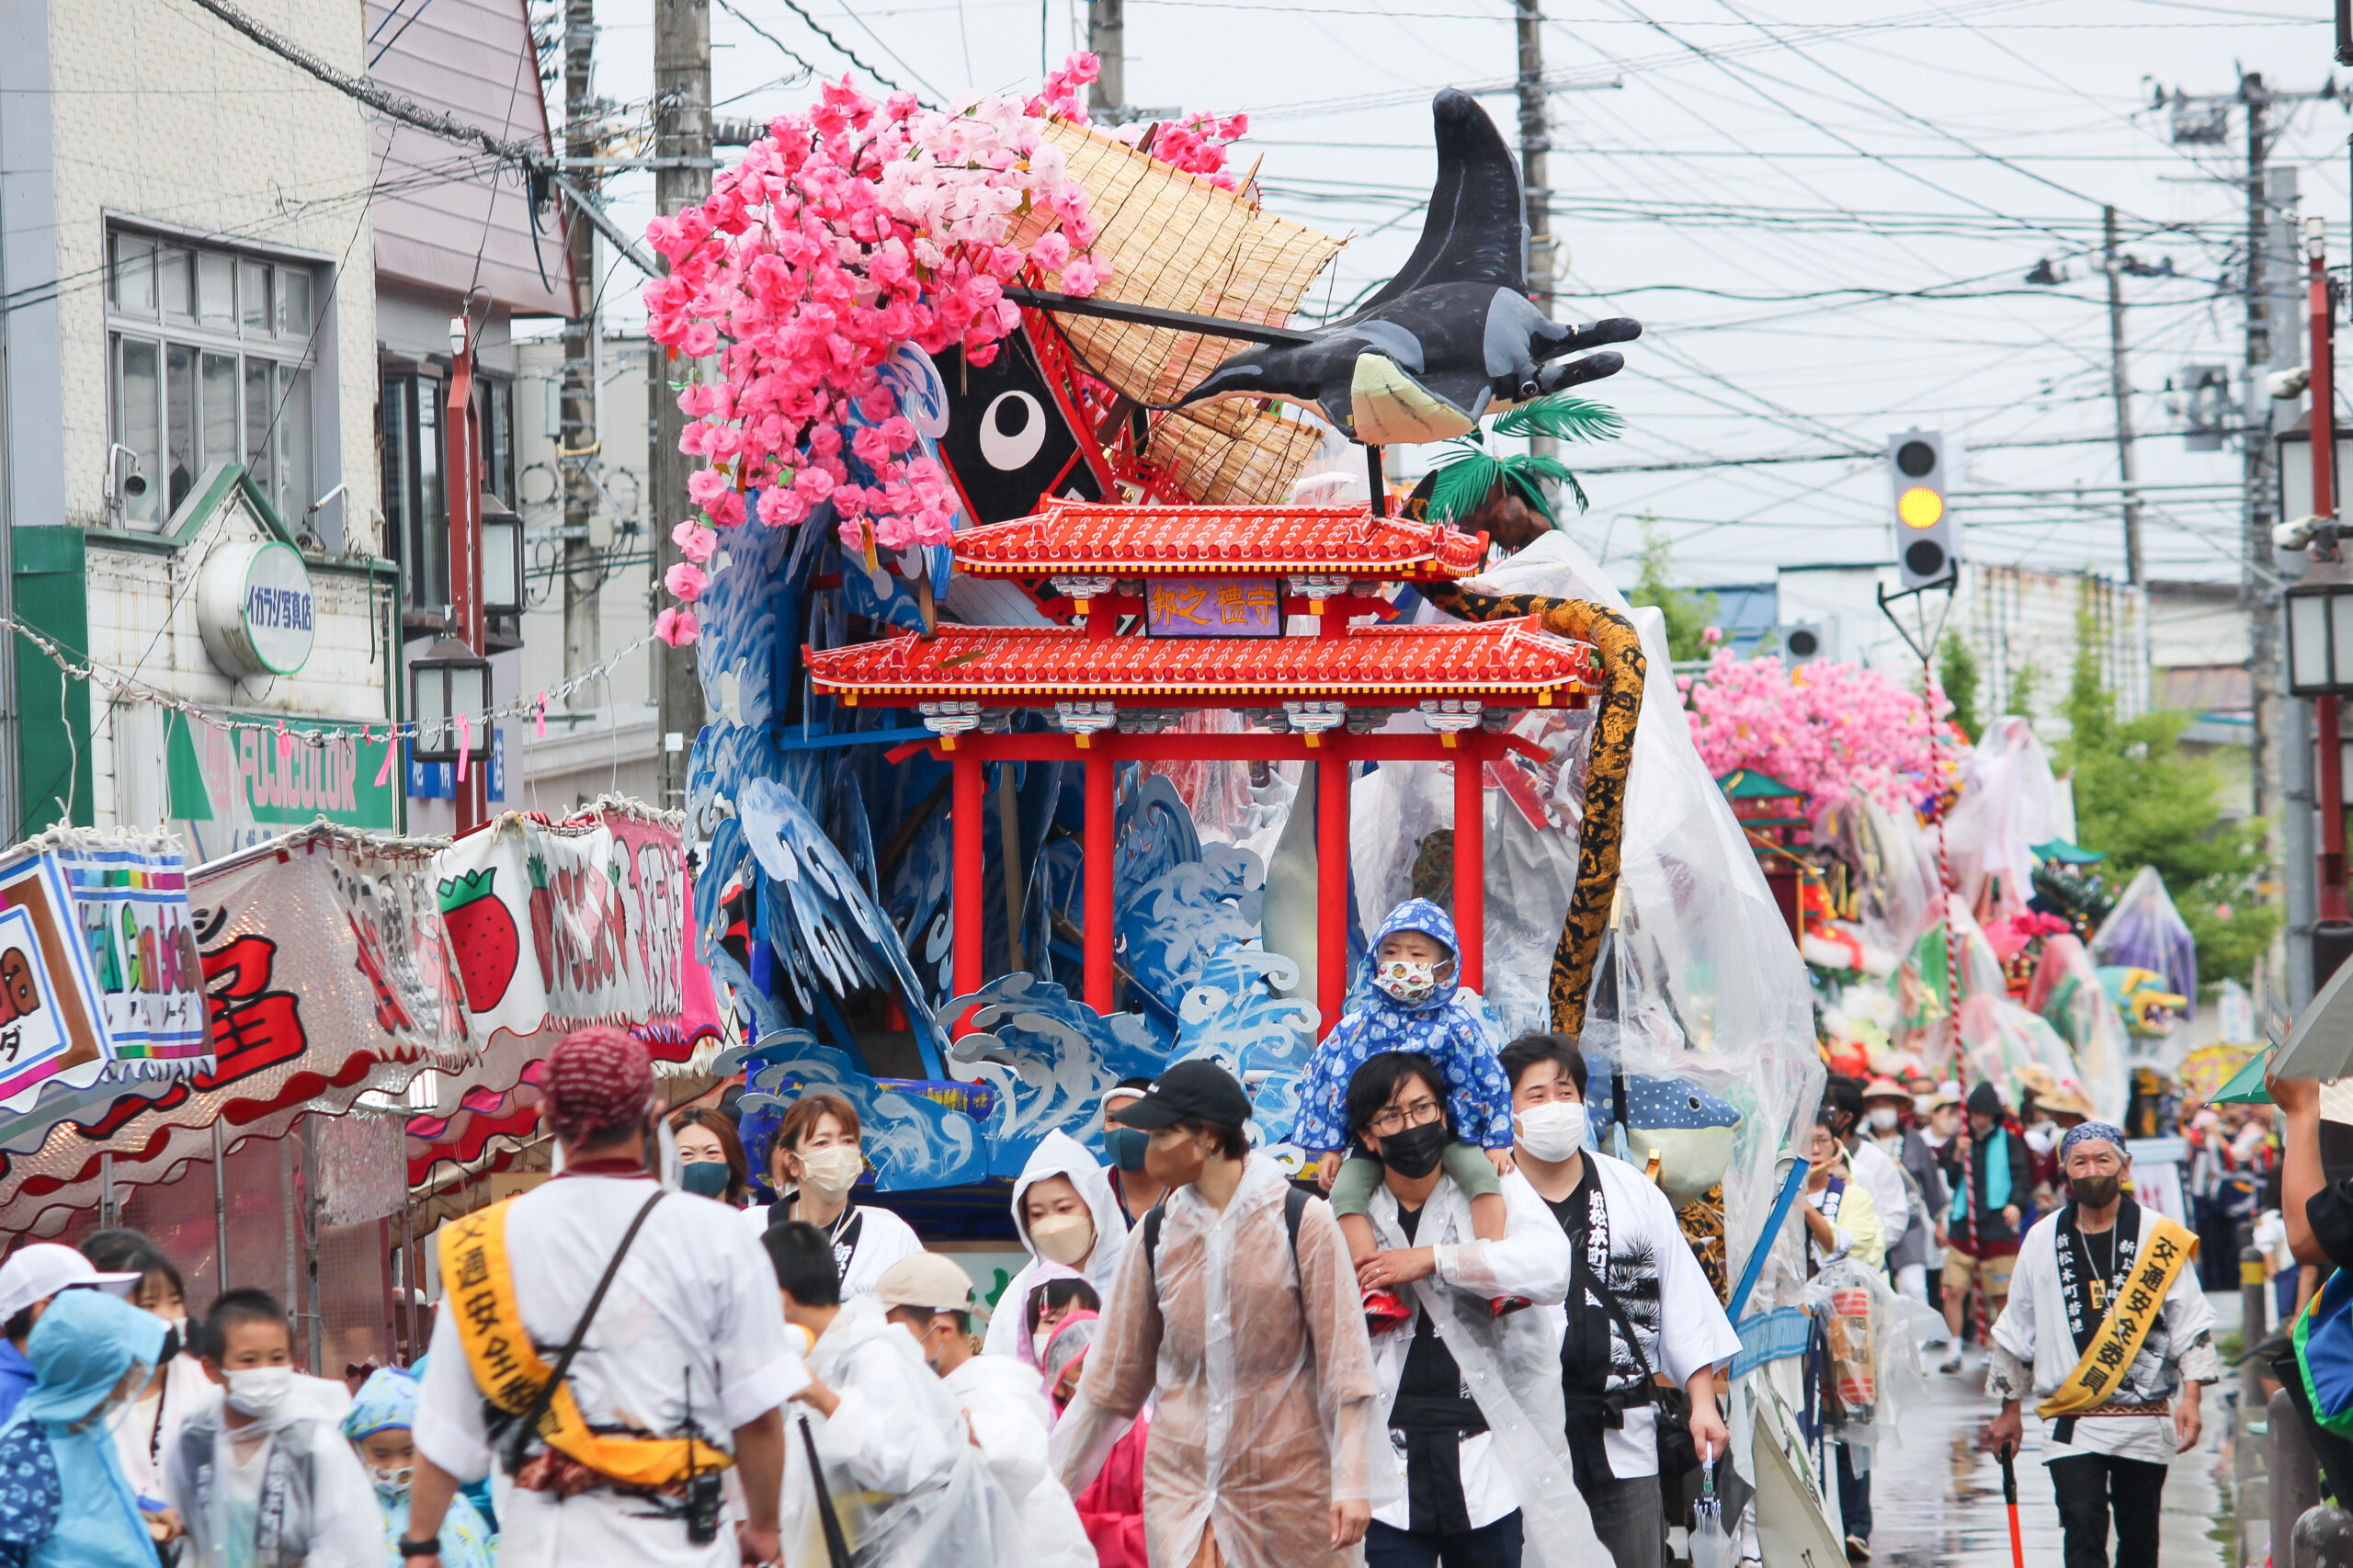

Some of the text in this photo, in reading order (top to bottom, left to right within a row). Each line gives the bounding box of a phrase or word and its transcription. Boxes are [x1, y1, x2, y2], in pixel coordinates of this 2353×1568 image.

[246, 585, 312, 631] イガラシ写真店
[239, 728, 358, 812] FUJICOLOR
[2078, 1236, 2179, 1396] 交通安全委員
